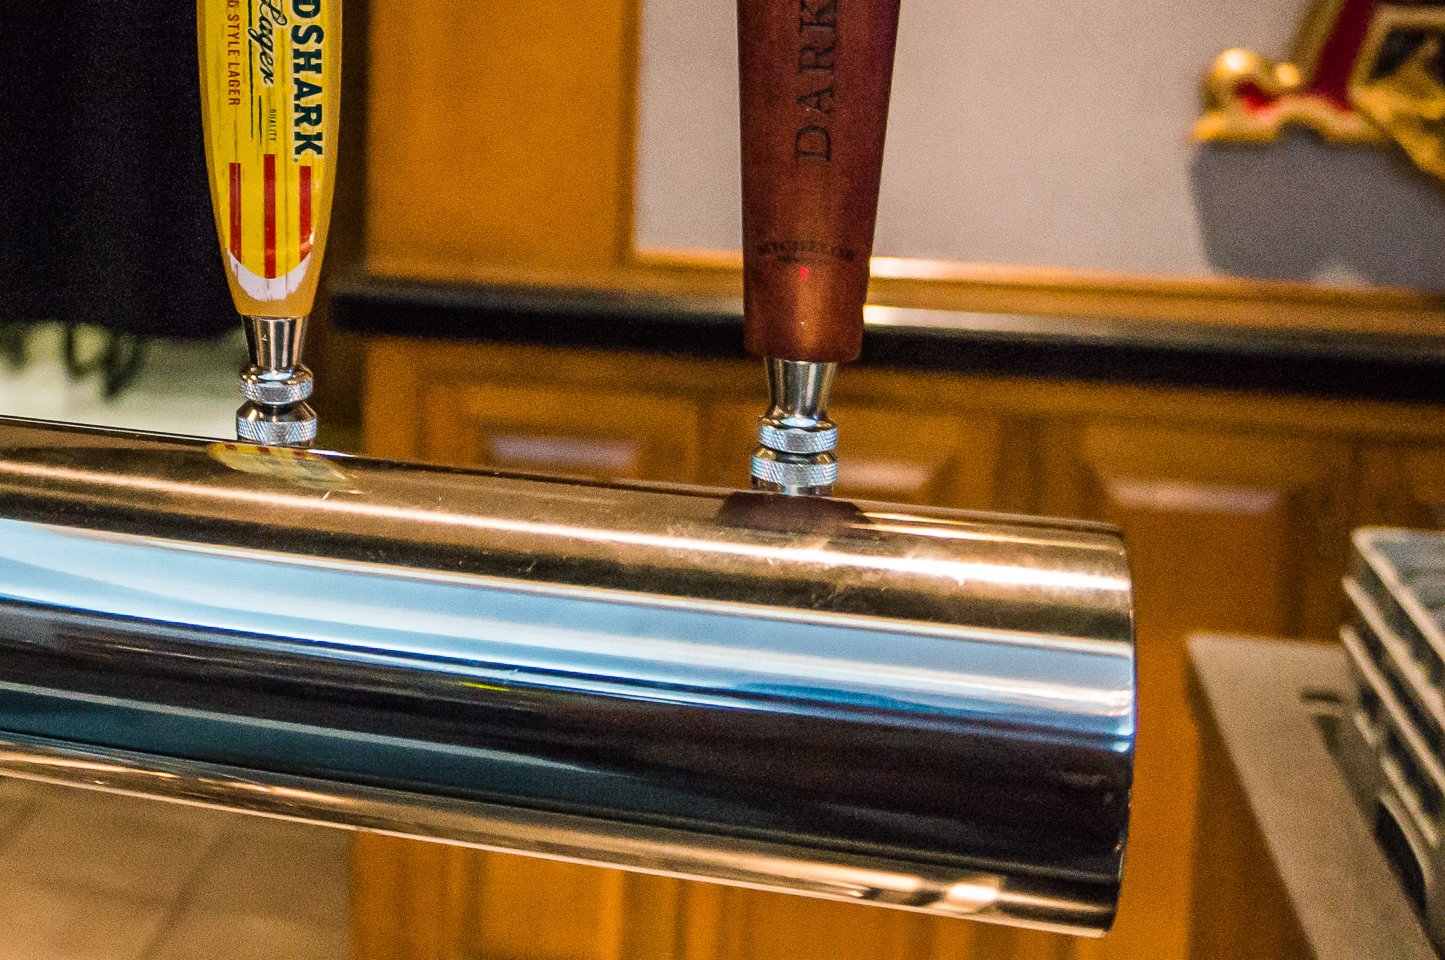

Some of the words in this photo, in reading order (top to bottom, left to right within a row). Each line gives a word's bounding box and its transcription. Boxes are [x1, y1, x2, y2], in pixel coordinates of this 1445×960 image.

[227, 14, 241, 56] STYLE
[227, 62, 241, 105] LAGER
[268, 108, 277, 141] QUALITY
